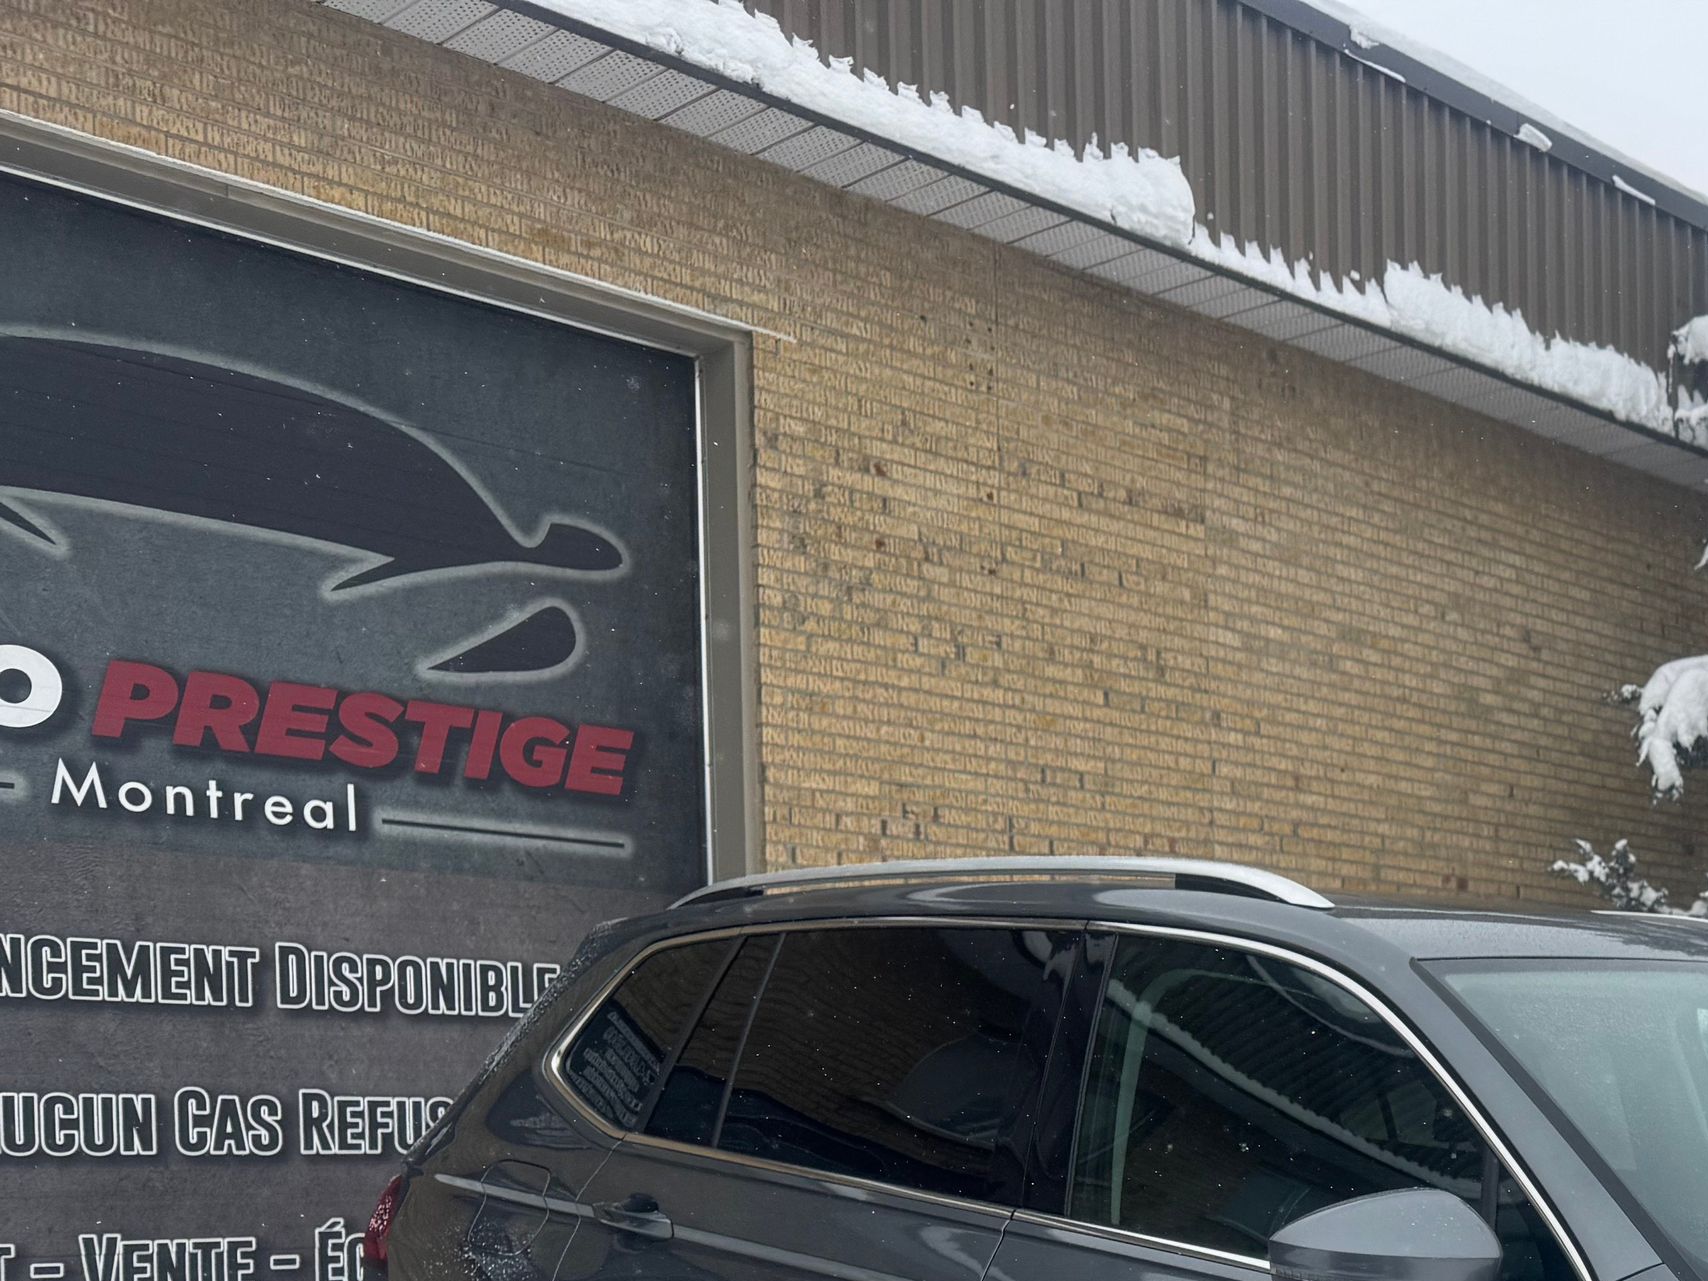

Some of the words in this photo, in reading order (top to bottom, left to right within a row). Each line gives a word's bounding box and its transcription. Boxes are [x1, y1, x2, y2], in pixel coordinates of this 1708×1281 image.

[92, 659, 635, 796] PRESTIGE
[51, 757, 357, 832] Montreal
[0, 1091, 158, 1156] UCUN
